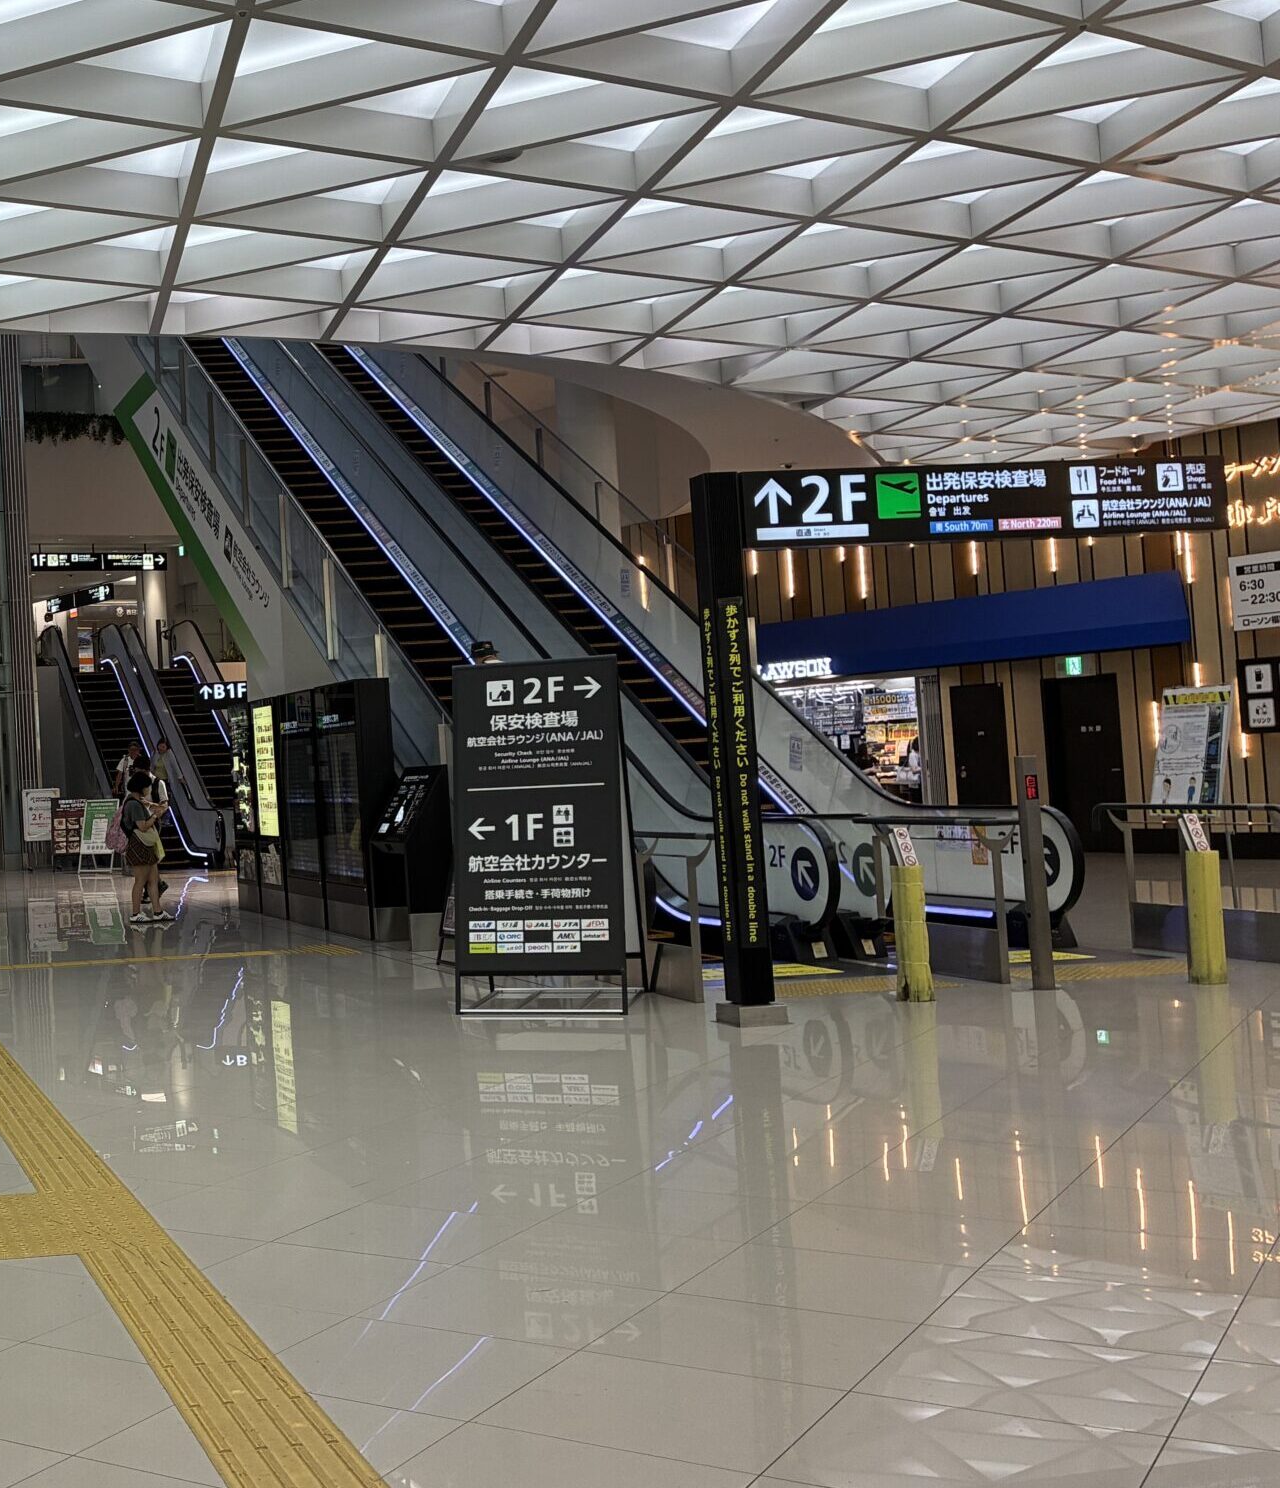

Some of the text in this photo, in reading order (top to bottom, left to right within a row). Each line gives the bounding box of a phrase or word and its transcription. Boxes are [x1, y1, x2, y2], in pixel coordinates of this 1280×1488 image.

[1099, 465, 1145, 477] フードホール
[1185, 463, 1206, 474] 売店
[926, 469, 1047, 491] 出発保安検査場
[1186, 475, 1206, 483] Shops
[801, 474, 867, 523] 2F
[927, 493, 990, 505] Departures
[1011, 518, 1036, 528] North
[1037, 517, 1059, 527] 220m
[1126, 511, 1150, 519] Lounge
[945, 522, 969, 531] South
[971, 521, 988, 530] 70m
[32, 554, 46, 566] 1F
[1239, 578, 1265, 591] 6:30
[757, 657, 832, 681] LAWSON
[213, 683, 247, 699] B1F
[523, 675, 565, 704] 2F
[725, 605, 749, 769] 歩かず2列でご利用ください
[490, 710, 579, 732] 保安検査場
[739, 773, 748, 788] Do
[740, 792, 750, 808] not
[505, 812, 544, 841] 1F
[742, 810, 751, 832] walk
[744, 834, 754, 863] stand
[769, 844, 786, 868] 2F
[468, 853, 607, 873] 航空会社カウンター
[745, 864, 754, 874] in
[485, 887, 592, 900] 搭乗手続き・手荷物預け
[747, 885, 757, 916] double
[749, 917, 758, 943] line
